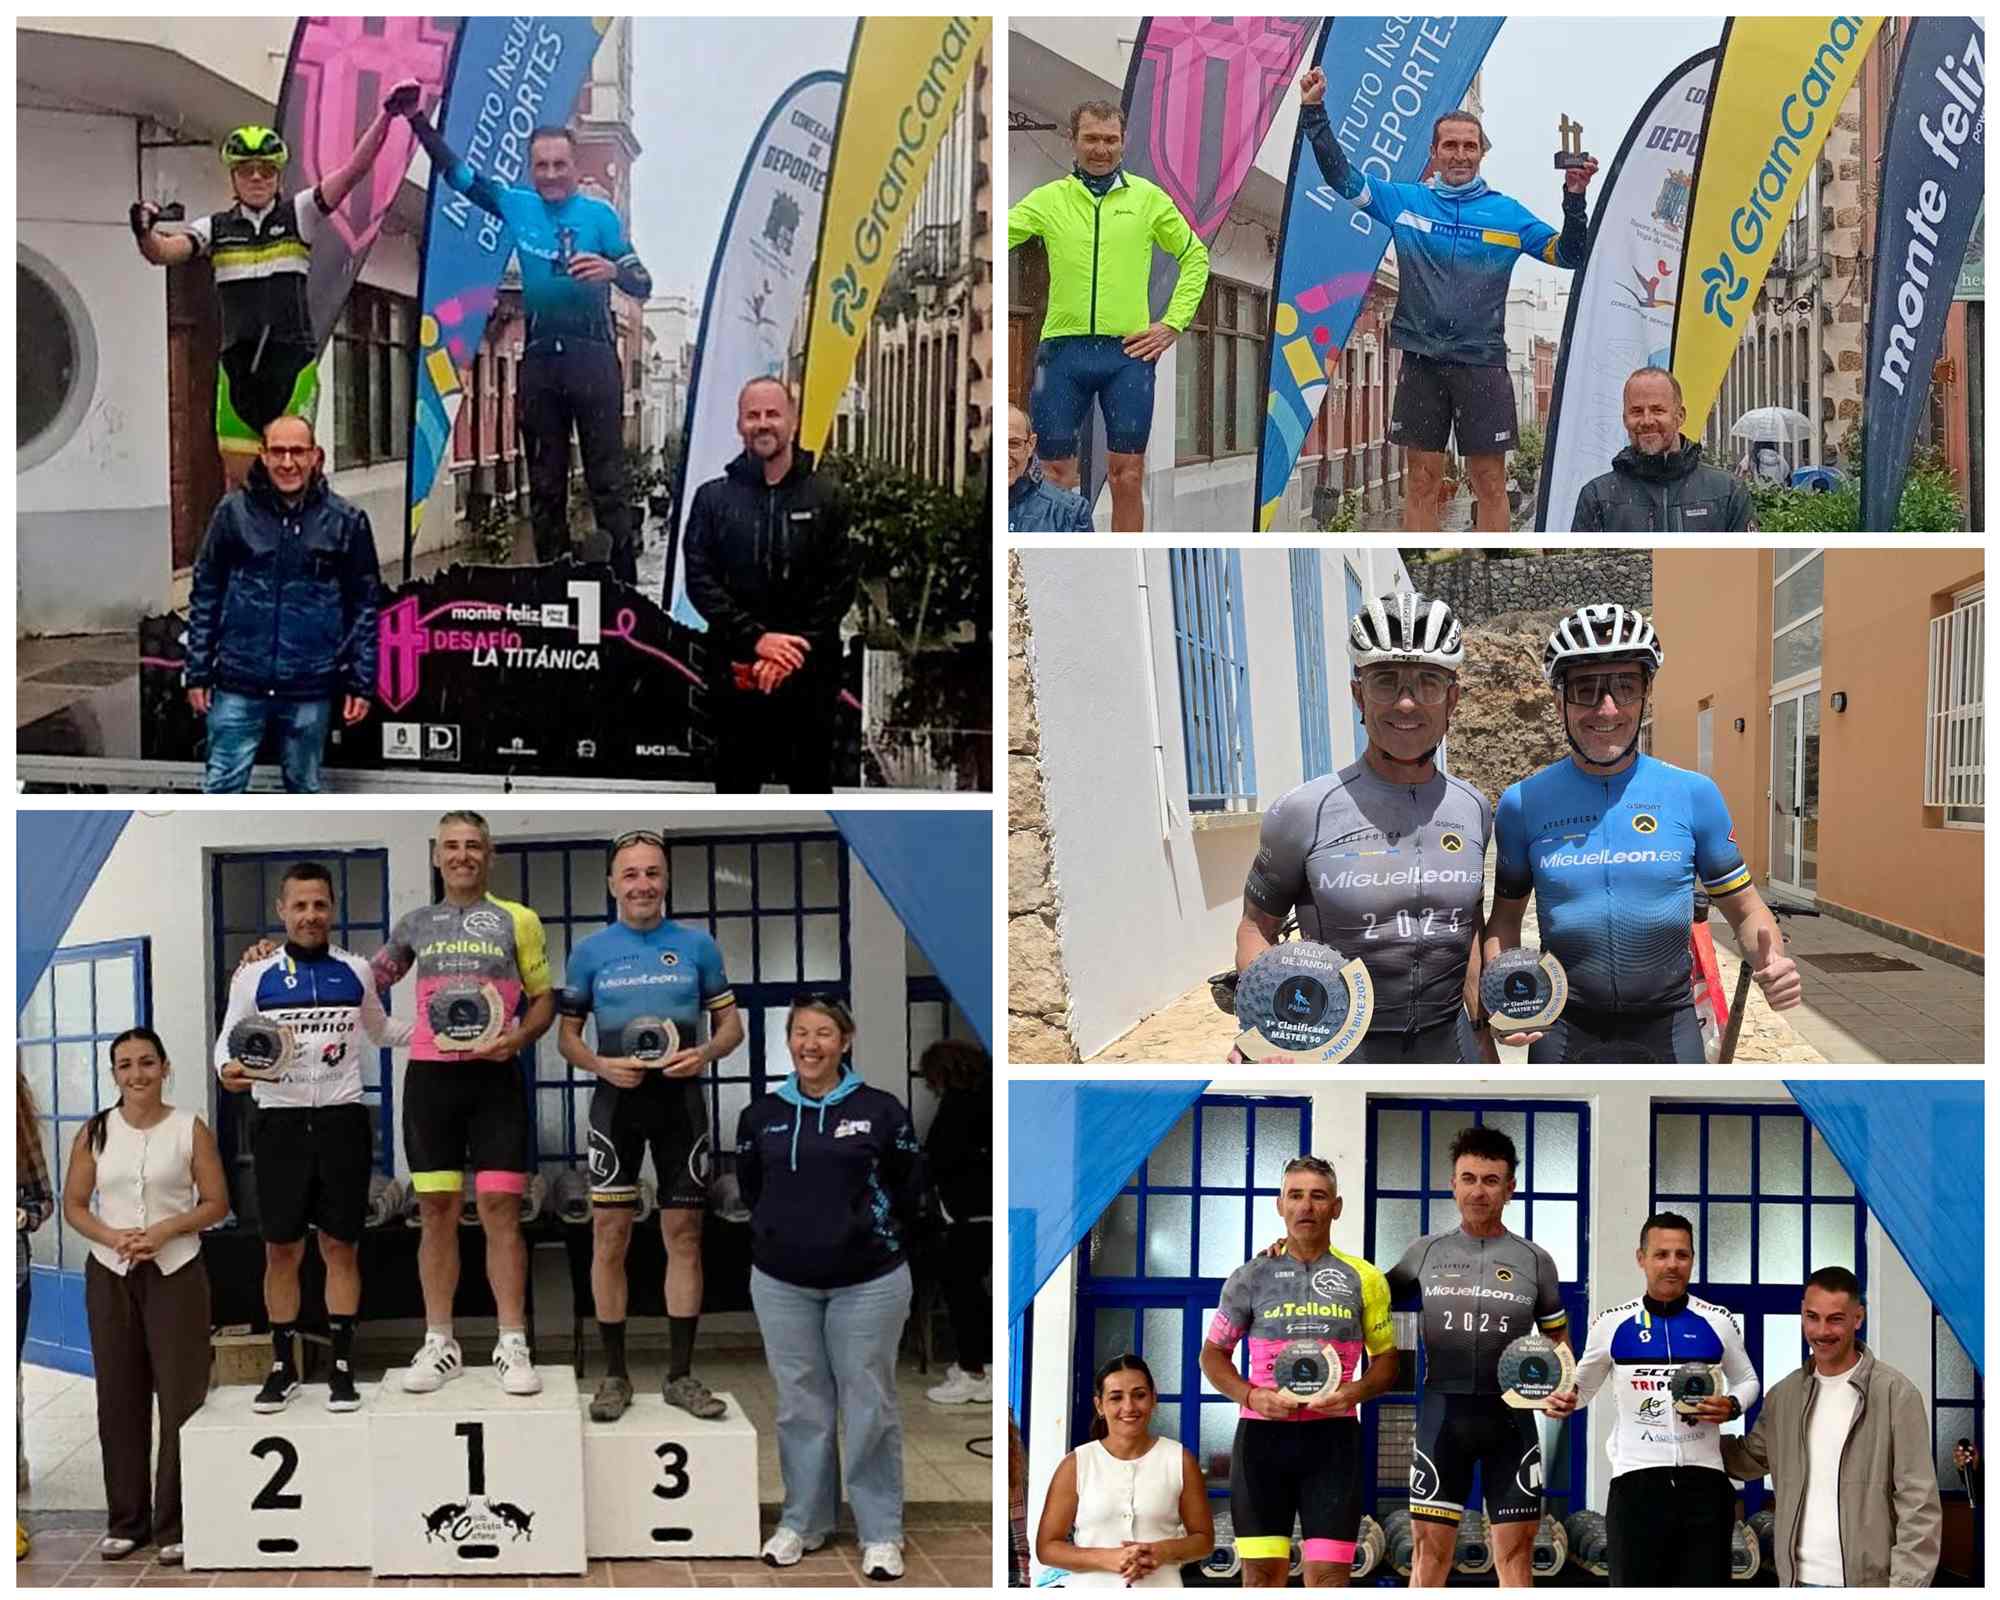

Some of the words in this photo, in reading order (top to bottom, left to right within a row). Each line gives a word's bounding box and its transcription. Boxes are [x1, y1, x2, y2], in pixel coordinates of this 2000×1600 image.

[1685, 87, 1707, 105] CO
[1305, 72, 1383, 212] INITUTO
[443, 92, 504, 229] INITUTO
[1350, 211, 1373, 236] D
[1881, 180, 1947, 396] monte
[1919, 34, 1984, 170] feliz
[1962, 273, 1984, 287] he
[452, 605, 501, 621] monte
[505, 602, 540, 623] feliz
[567, 580, 600, 645] 1
[434, 627, 522, 651] DESAFÍO
[472, 646, 499, 668] LA
[504, 644, 600, 671] TITÁNICA
[1281, 956, 1296, 967] DE
[1293, 946, 1326, 958] RALLY
[1277, 1020, 1330, 1035] Clasificado
[1309, 1034, 1321, 1043] 50
[1443, 1310, 1510, 1333] 2025
[454, 1422, 486, 1496] 1
[652, 1441, 691, 1500] 3
[250, 1436, 303, 1510] 2
